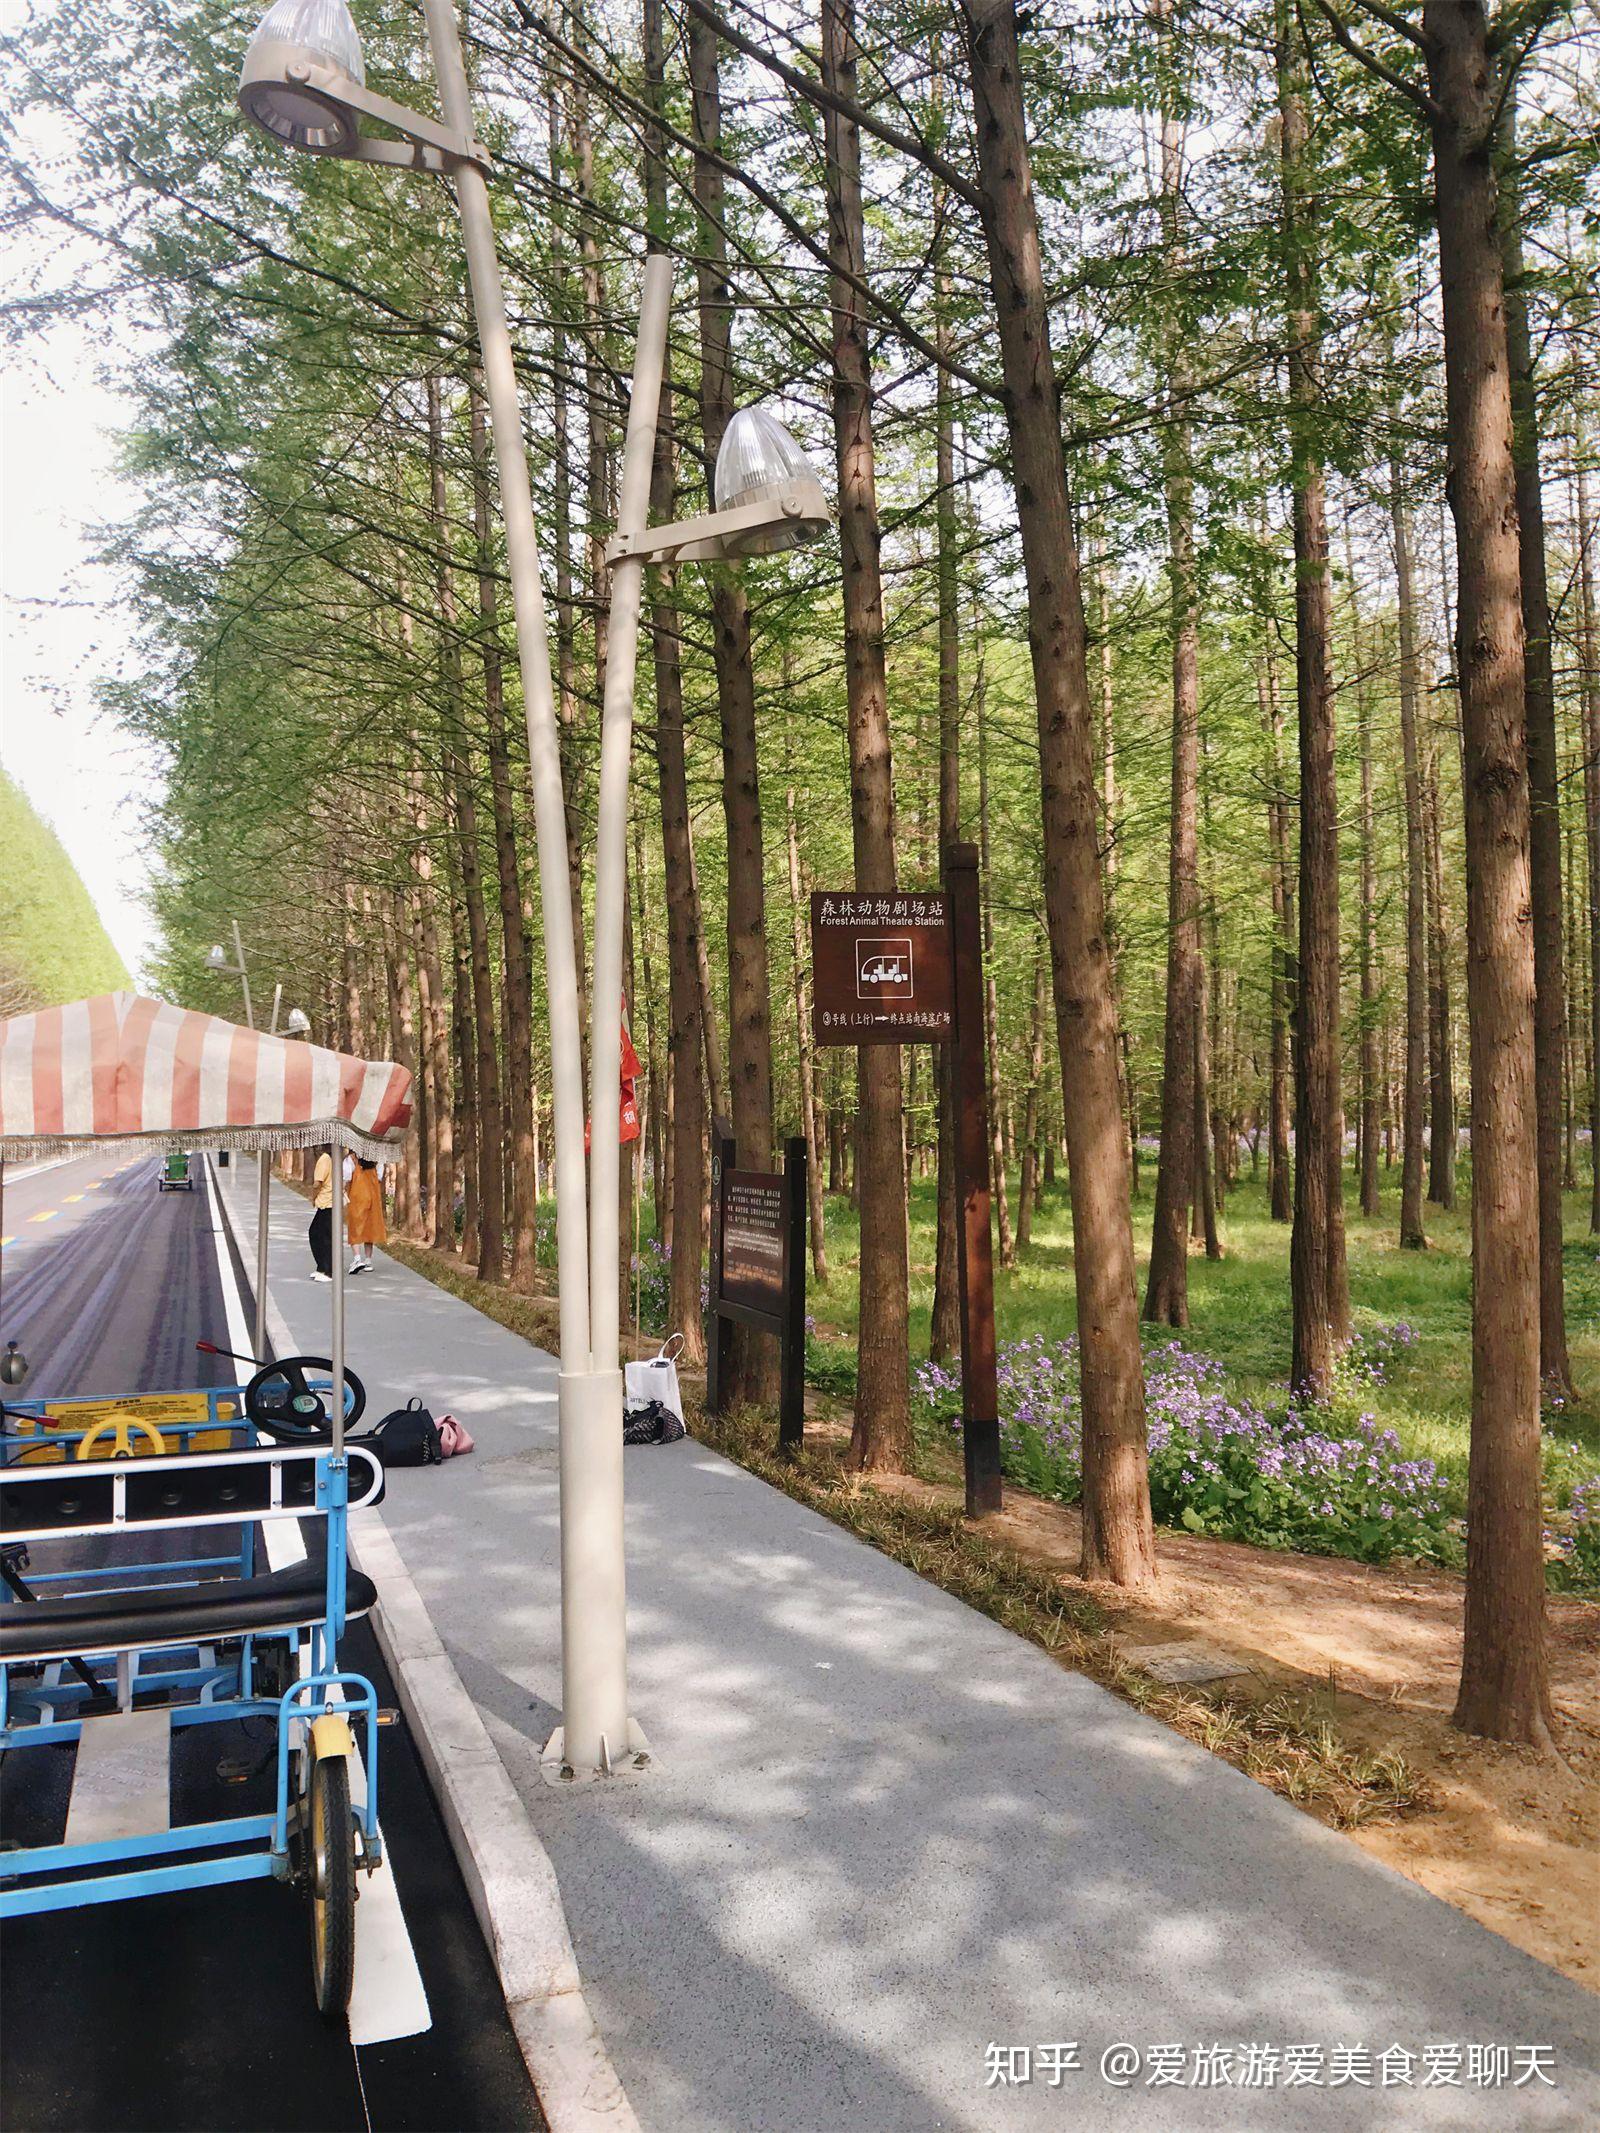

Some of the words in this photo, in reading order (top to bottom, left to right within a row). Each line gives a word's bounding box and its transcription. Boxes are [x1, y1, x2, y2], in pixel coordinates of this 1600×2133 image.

[820, 898, 943, 916] 森林动物剧场站
[820, 916, 848, 926] Forest
[850, 916, 879, 926] Animal
[881, 917, 913, 926] Theatre
[915, 917, 945, 926] Station
